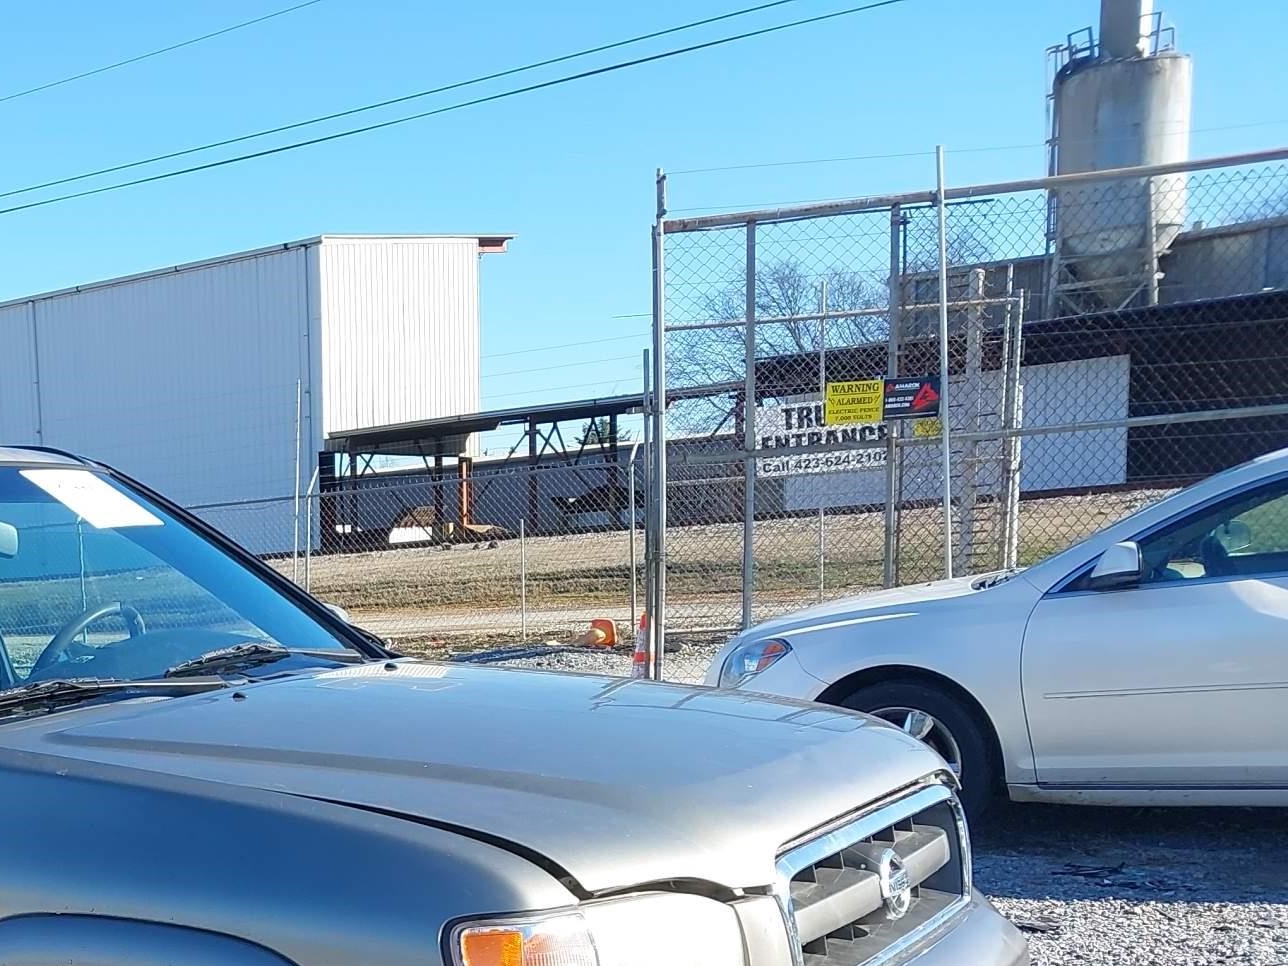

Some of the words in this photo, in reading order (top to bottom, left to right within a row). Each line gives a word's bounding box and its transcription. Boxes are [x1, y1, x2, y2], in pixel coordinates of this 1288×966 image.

[831, 383, 880, 394] WARNING
[836, 397, 873, 406] ALARMED
[762, 460, 790, 473] Call
